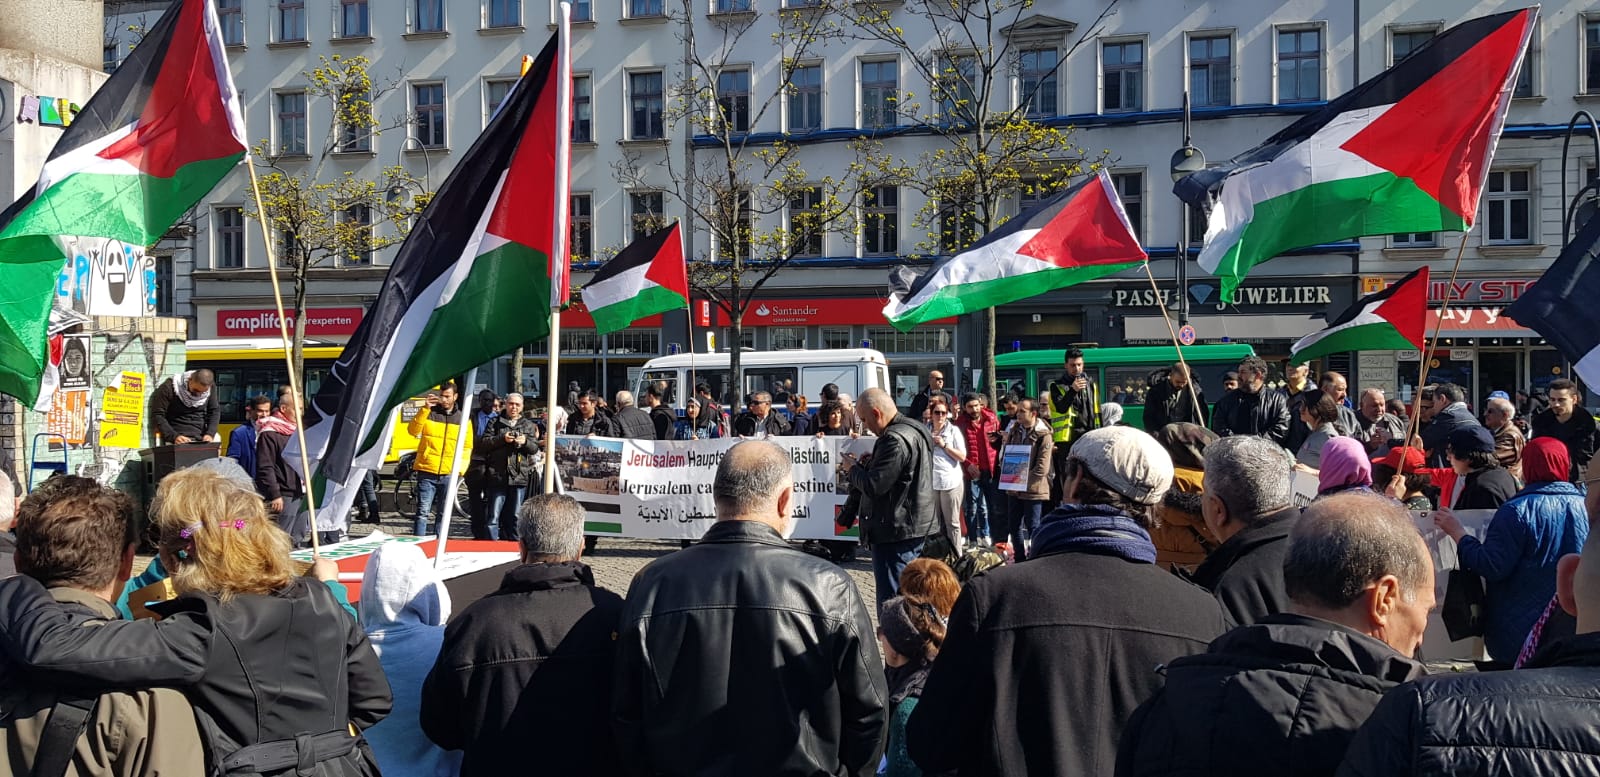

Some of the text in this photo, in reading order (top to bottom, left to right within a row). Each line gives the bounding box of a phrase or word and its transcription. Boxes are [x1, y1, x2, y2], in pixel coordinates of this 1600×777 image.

[772, 305, 817, 315] Santander
[304, 317, 352, 327] rexperten
[627, 446, 830, 470] Jerusalem Haupts lästina
[620, 477, 834, 495] Jerusalem ca estine
